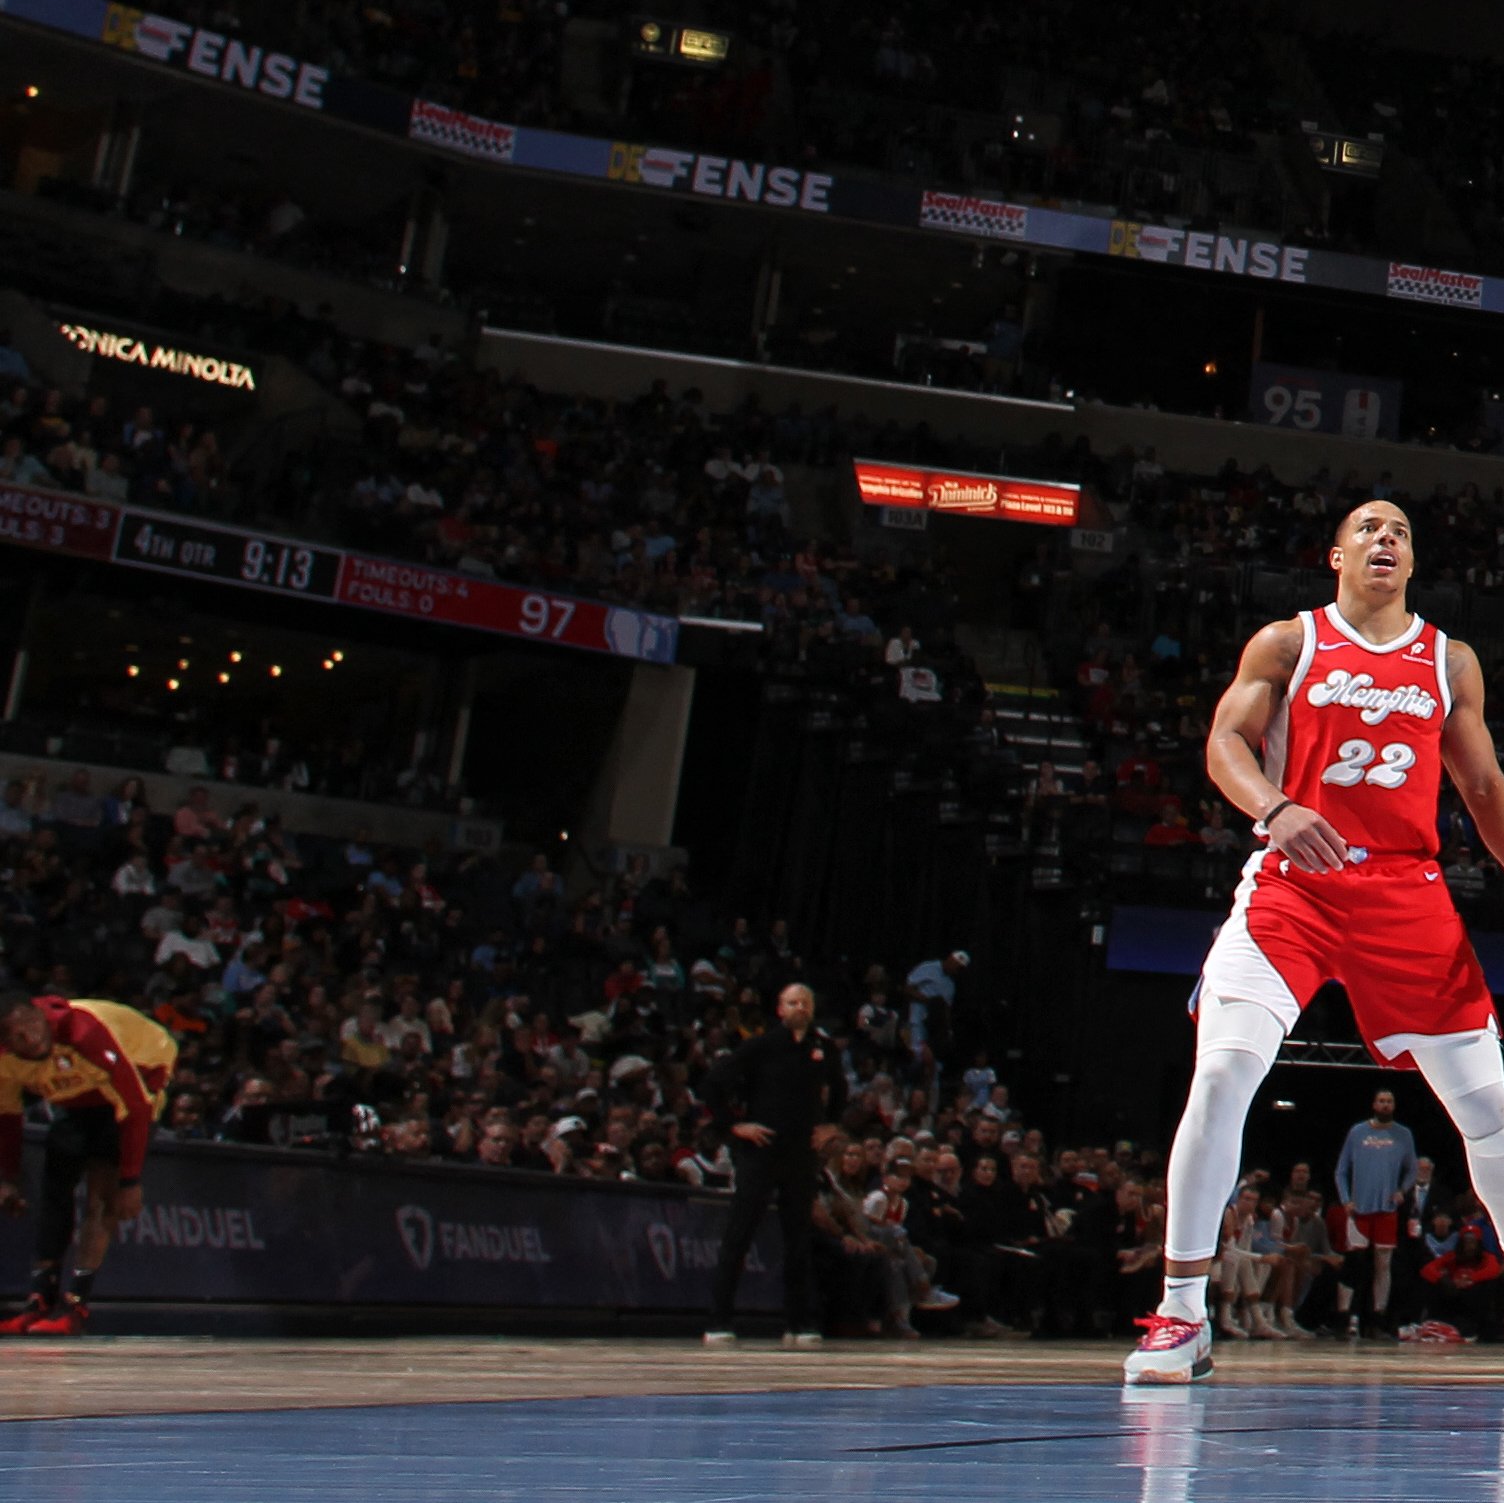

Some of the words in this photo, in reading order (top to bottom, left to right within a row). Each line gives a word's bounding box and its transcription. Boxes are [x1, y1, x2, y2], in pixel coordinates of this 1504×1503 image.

[923, 190, 1025, 219] SealMaster
[1390, 263, 1480, 290] SealMaster
[150, 346, 256, 392] MINOLTA
[1264, 386, 1323, 431] 95
[134, 523, 175, 561] 4TH
[241, 539, 315, 590] 9:13
[518, 594, 577, 639] 97
[1307, 669, 1438, 726] Memphis
[1320, 738, 1417, 789] 22
[117, 1205, 267, 1251] FANDUEL
[438, 1220, 553, 1264] FANDUEL
